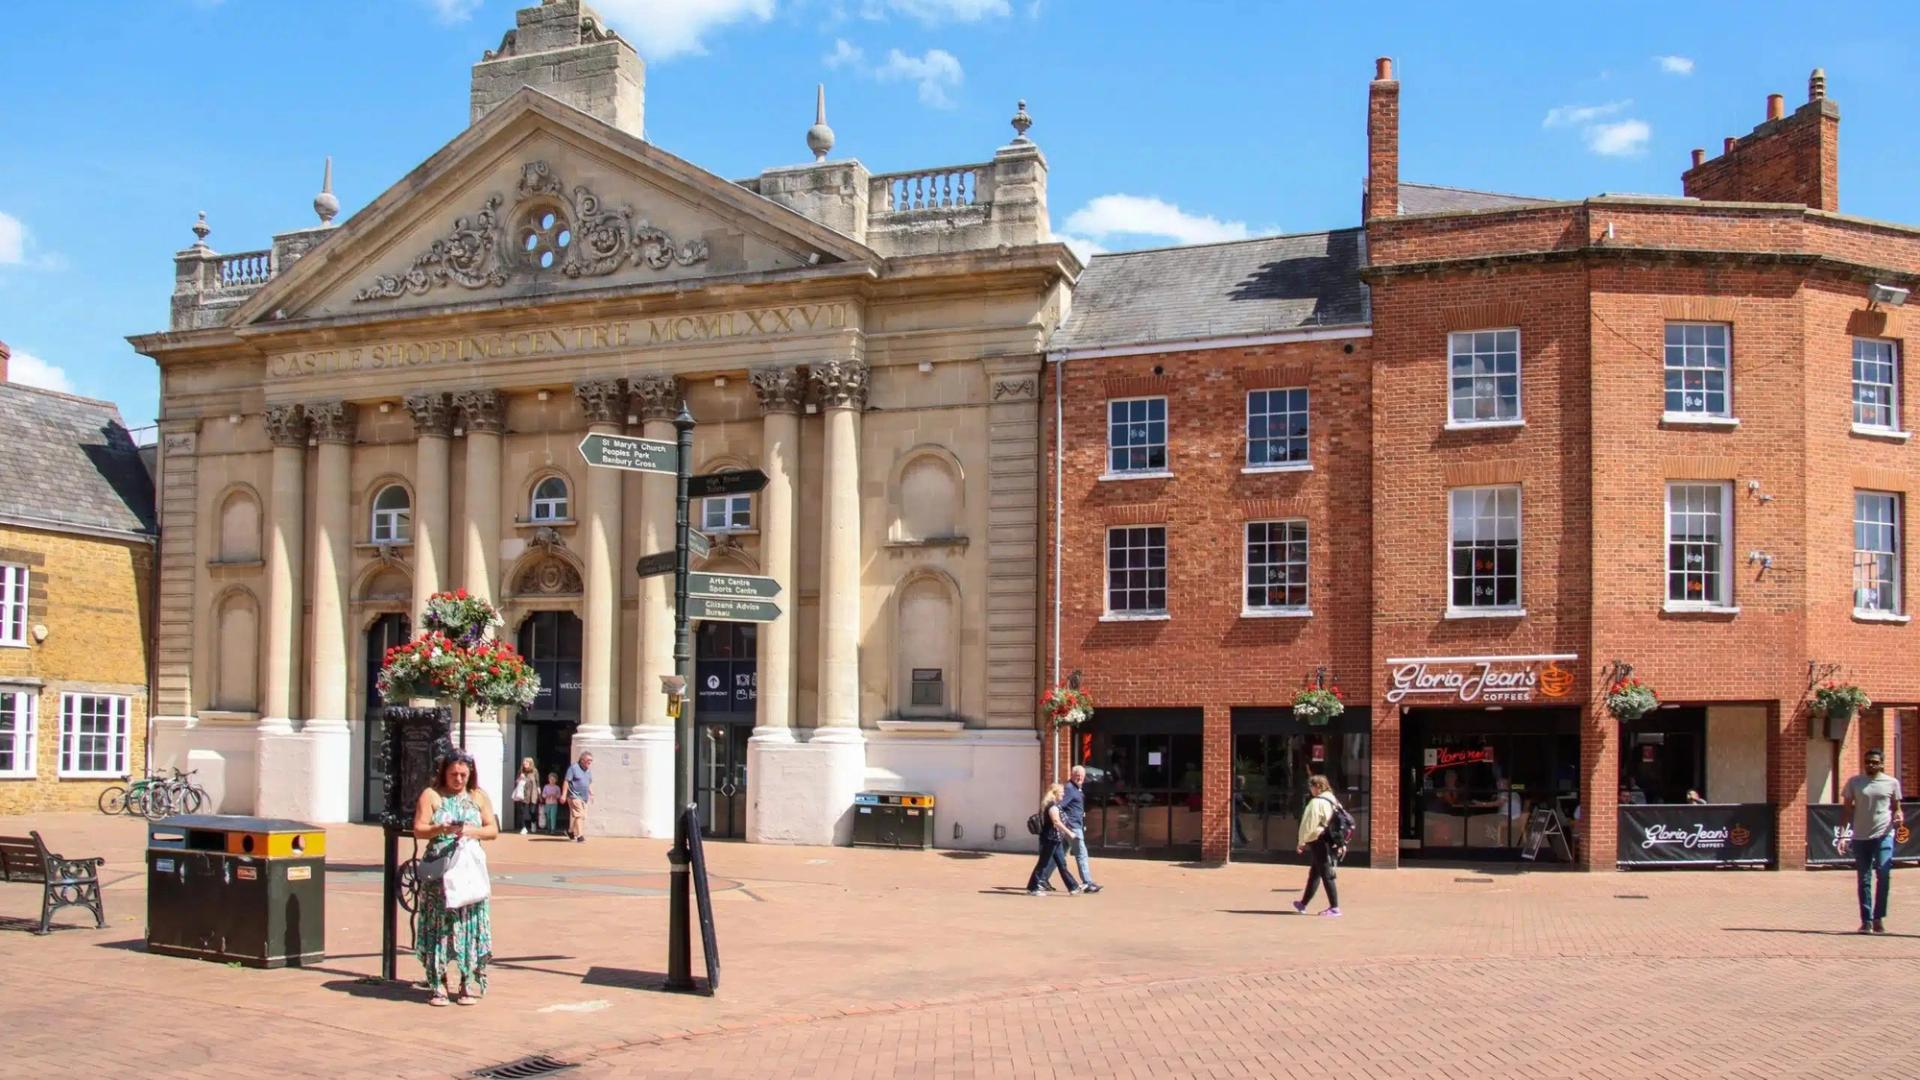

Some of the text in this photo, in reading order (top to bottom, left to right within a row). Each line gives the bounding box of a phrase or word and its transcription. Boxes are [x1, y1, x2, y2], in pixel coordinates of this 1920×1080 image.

[270, 303, 848, 377] CASTLE SHOPPING CENTRE MCMLXXVII
[602, 438, 667, 453] St Mary's Church
[602, 447, 650, 459] Peoples Park
[602, 455, 656, 468] Banbury Cross
[709, 577, 751, 587] Arts Centre
[709, 585, 758, 595] Sports Centre
[705, 600, 760, 611] Citizens Advice
[705, 608, 730, 617] Bureau
[1387, 662, 1536, 702] Gloria Jean's
[1483, 692, 1531, 701] COFFEES
[1641, 824, 1729, 849] Gloria Jean's
